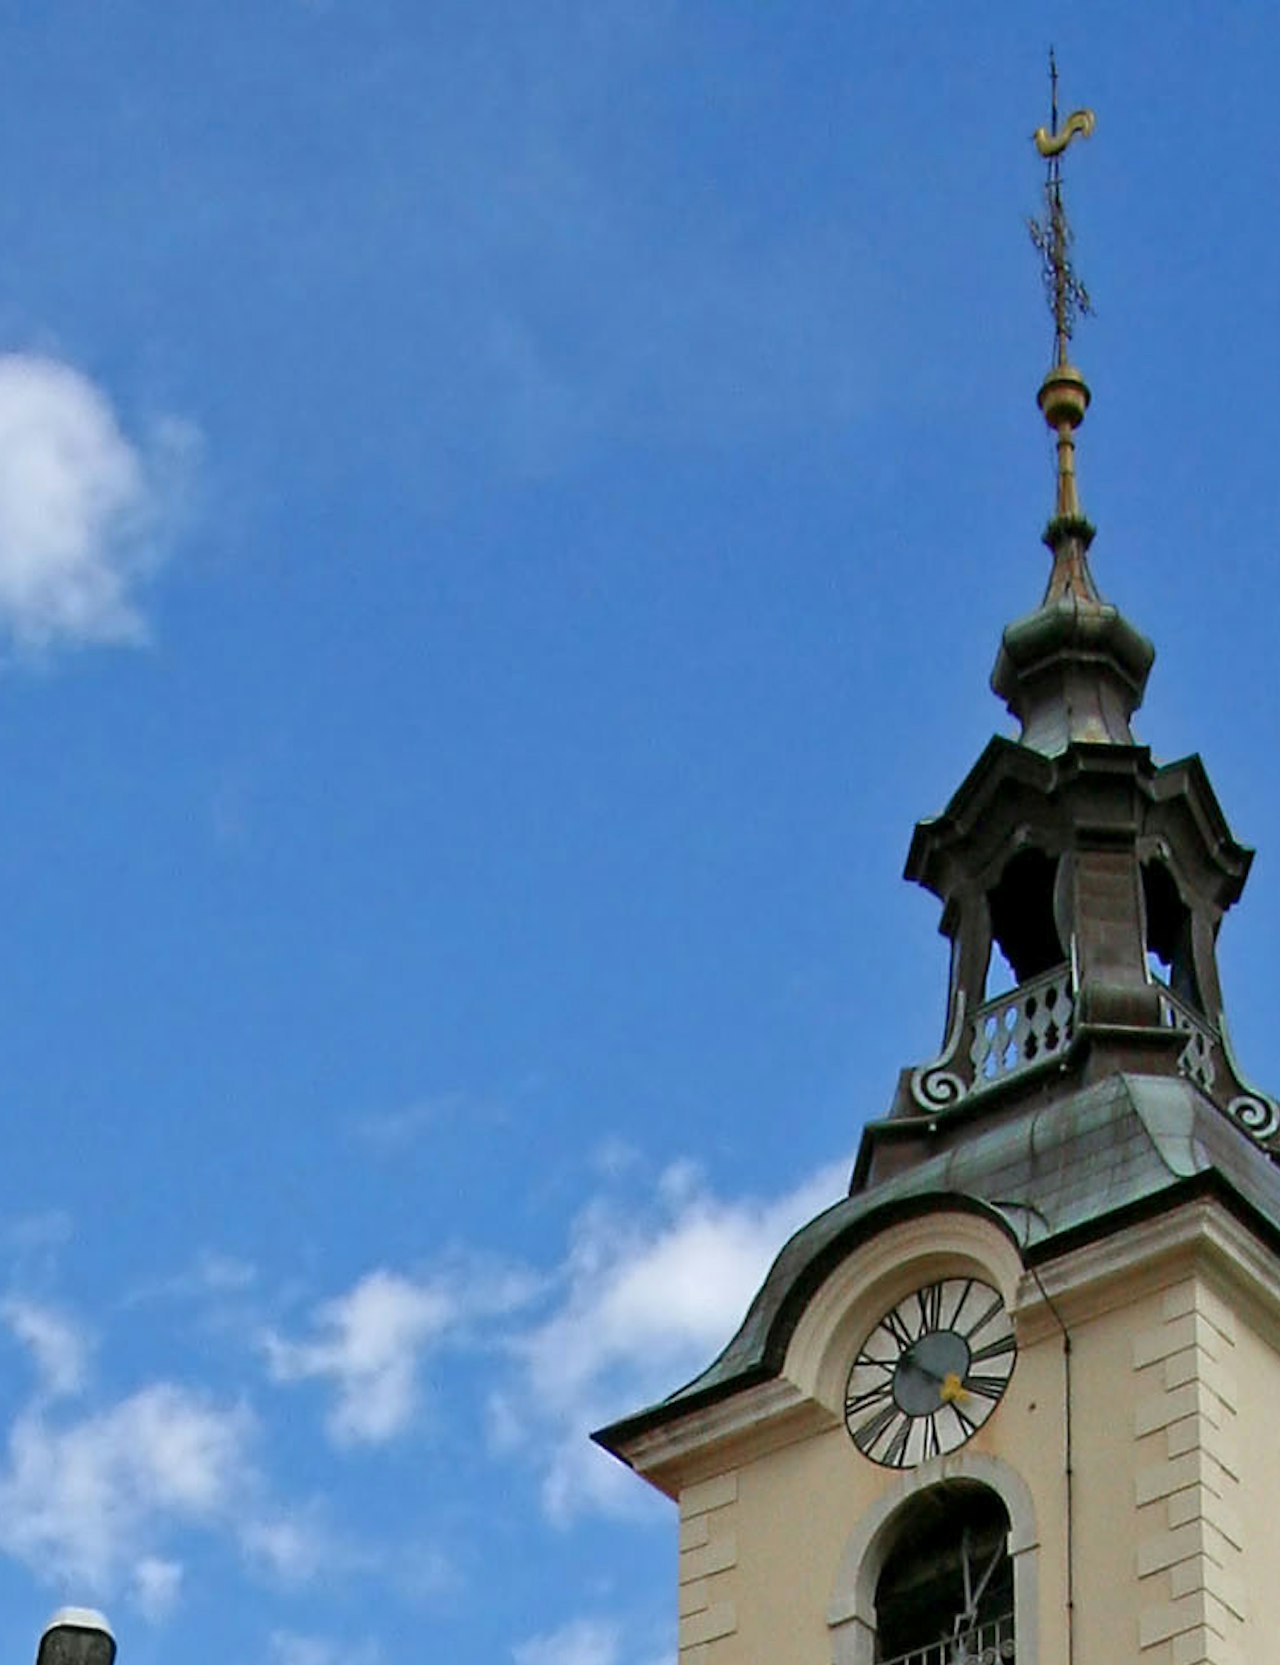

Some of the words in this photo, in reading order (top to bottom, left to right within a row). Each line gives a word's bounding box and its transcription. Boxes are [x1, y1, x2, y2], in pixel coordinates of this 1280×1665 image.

[918, 1285, 943, 1334] XII
[879, 1309, 918, 1355] XI
[855, 1354, 901, 1377] X
[846, 1380, 894, 1416] IX
